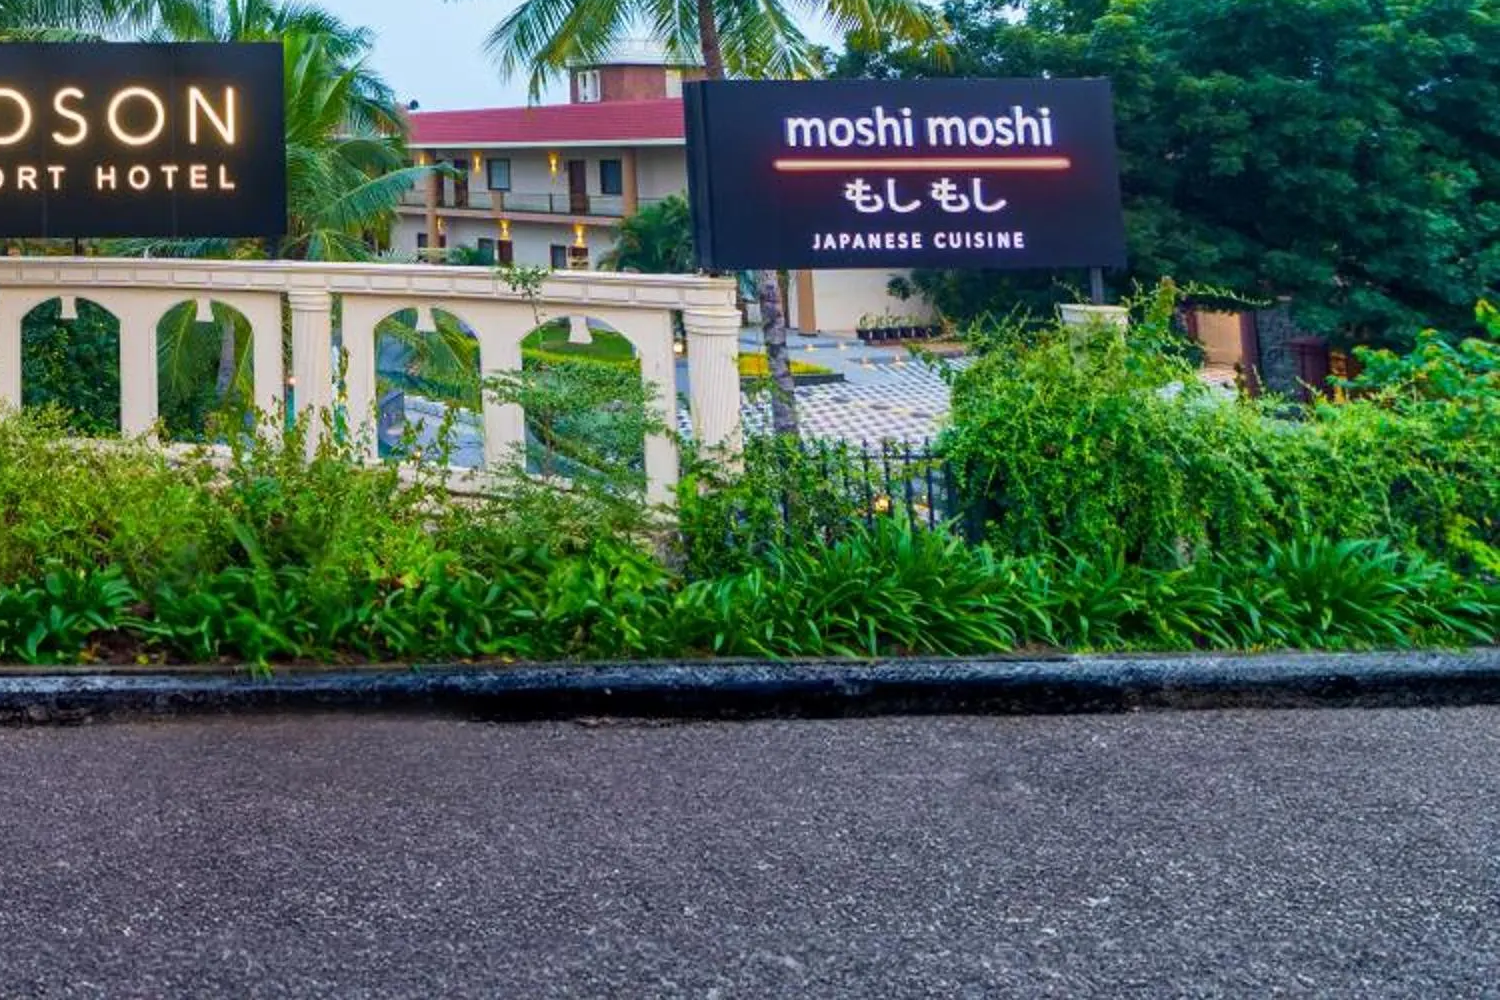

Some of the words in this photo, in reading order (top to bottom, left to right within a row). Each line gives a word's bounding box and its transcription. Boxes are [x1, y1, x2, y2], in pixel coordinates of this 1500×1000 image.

[786, 105, 914, 147] moshi
[926, 105, 1053, 147] moshi
[96, 164, 236, 190] HOTEL
[812, 232, 923, 250] JAPANESE
[933, 231, 1025, 249] CUISINE
